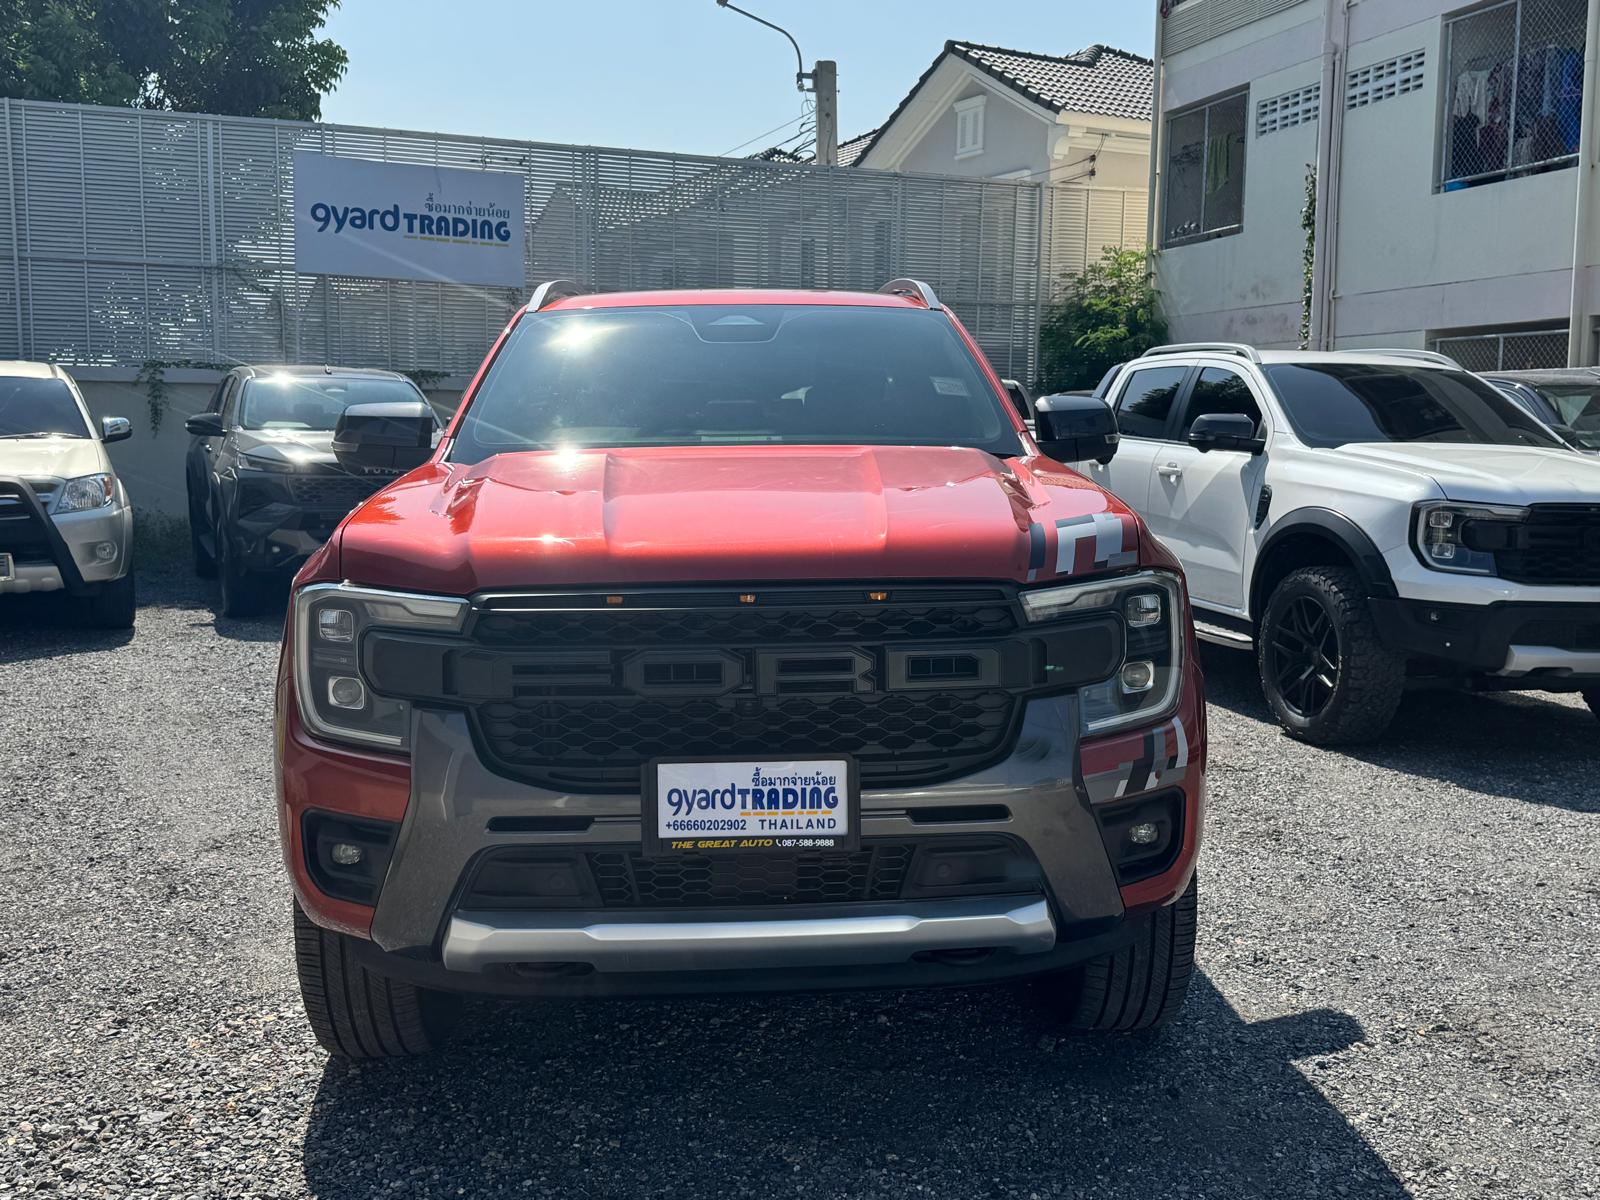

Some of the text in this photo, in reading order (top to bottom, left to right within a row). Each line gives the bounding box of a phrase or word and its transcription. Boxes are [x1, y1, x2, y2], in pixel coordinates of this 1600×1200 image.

[403, 213, 511, 242] TRADING
[490, 647, 1001, 698] FORD
[751, 767, 836, 787] ซื้อมากจ่ายน้อย
[737, 786, 838, 810] TRADING
[665, 818, 836, 831] +66660202902 THAILAND
[671, 838, 835, 849] THE GREAT AUTO 087-588-9888
